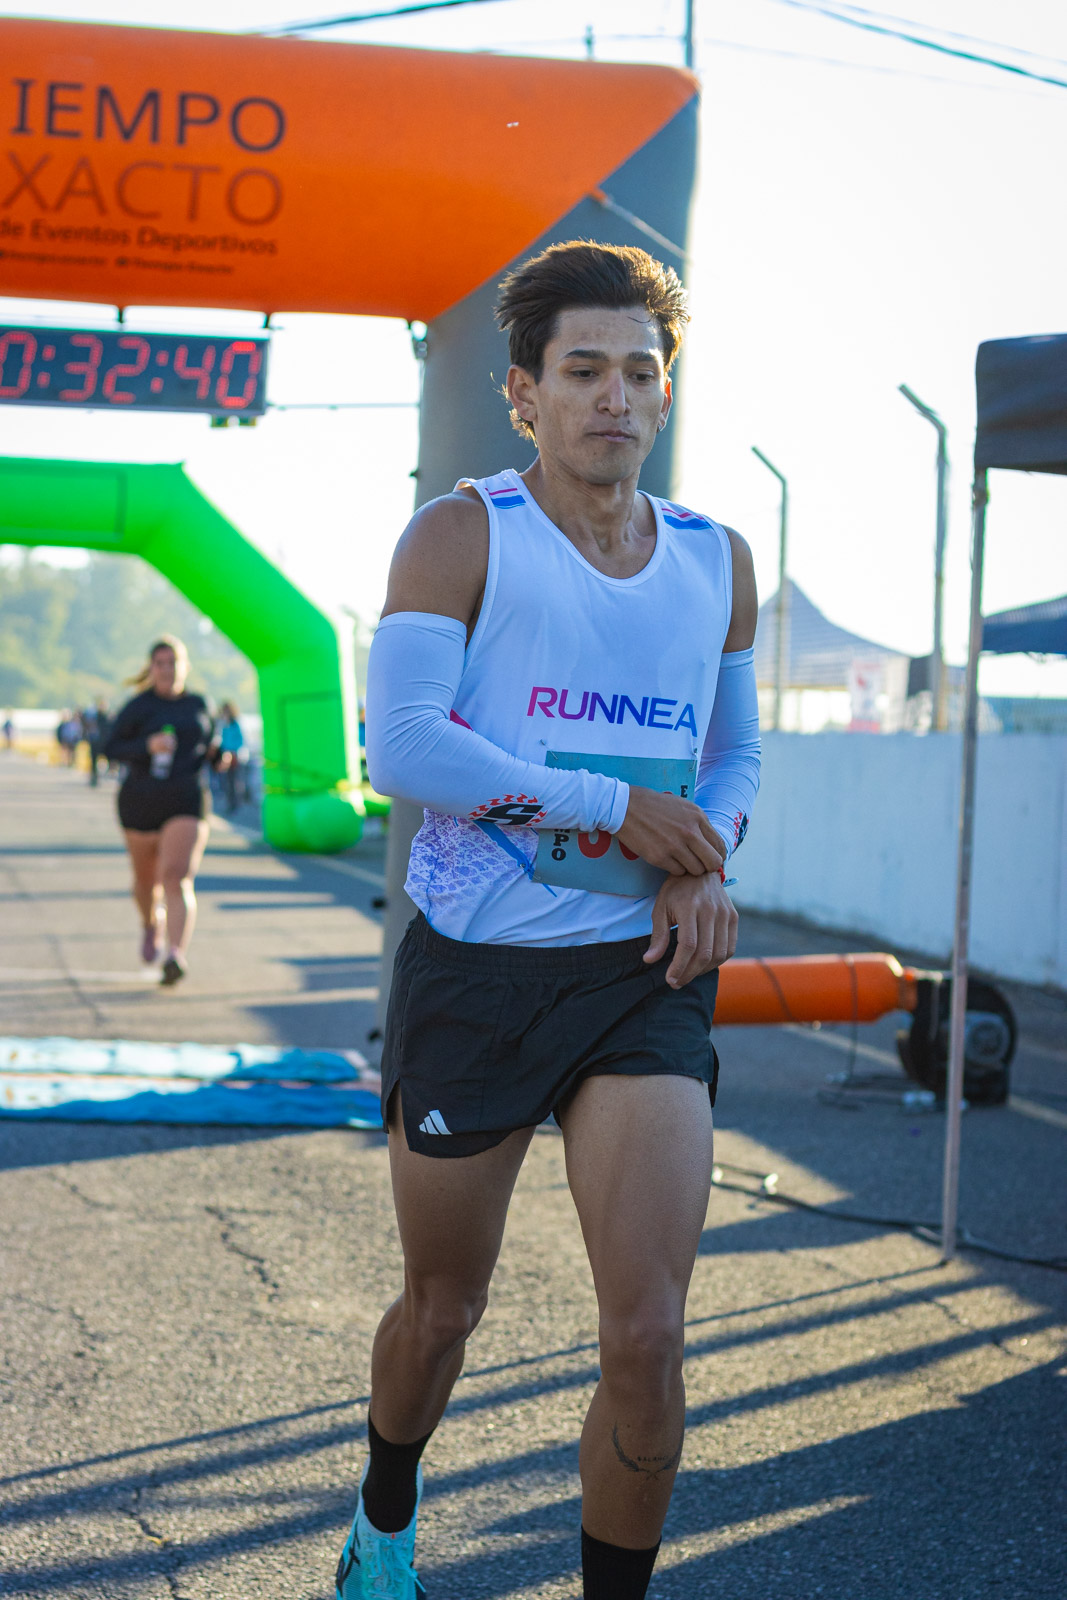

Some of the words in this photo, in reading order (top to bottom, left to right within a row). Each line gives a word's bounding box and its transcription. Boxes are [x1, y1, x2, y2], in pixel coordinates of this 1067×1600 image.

[11, 77, 286, 153] IEMPO
[3, 151, 282, 227] XACTO
[31, 218, 130, 246] Eventos
[137, 226, 278, 255] Deportivos
[527, 686, 698, 737] RUNNEA
